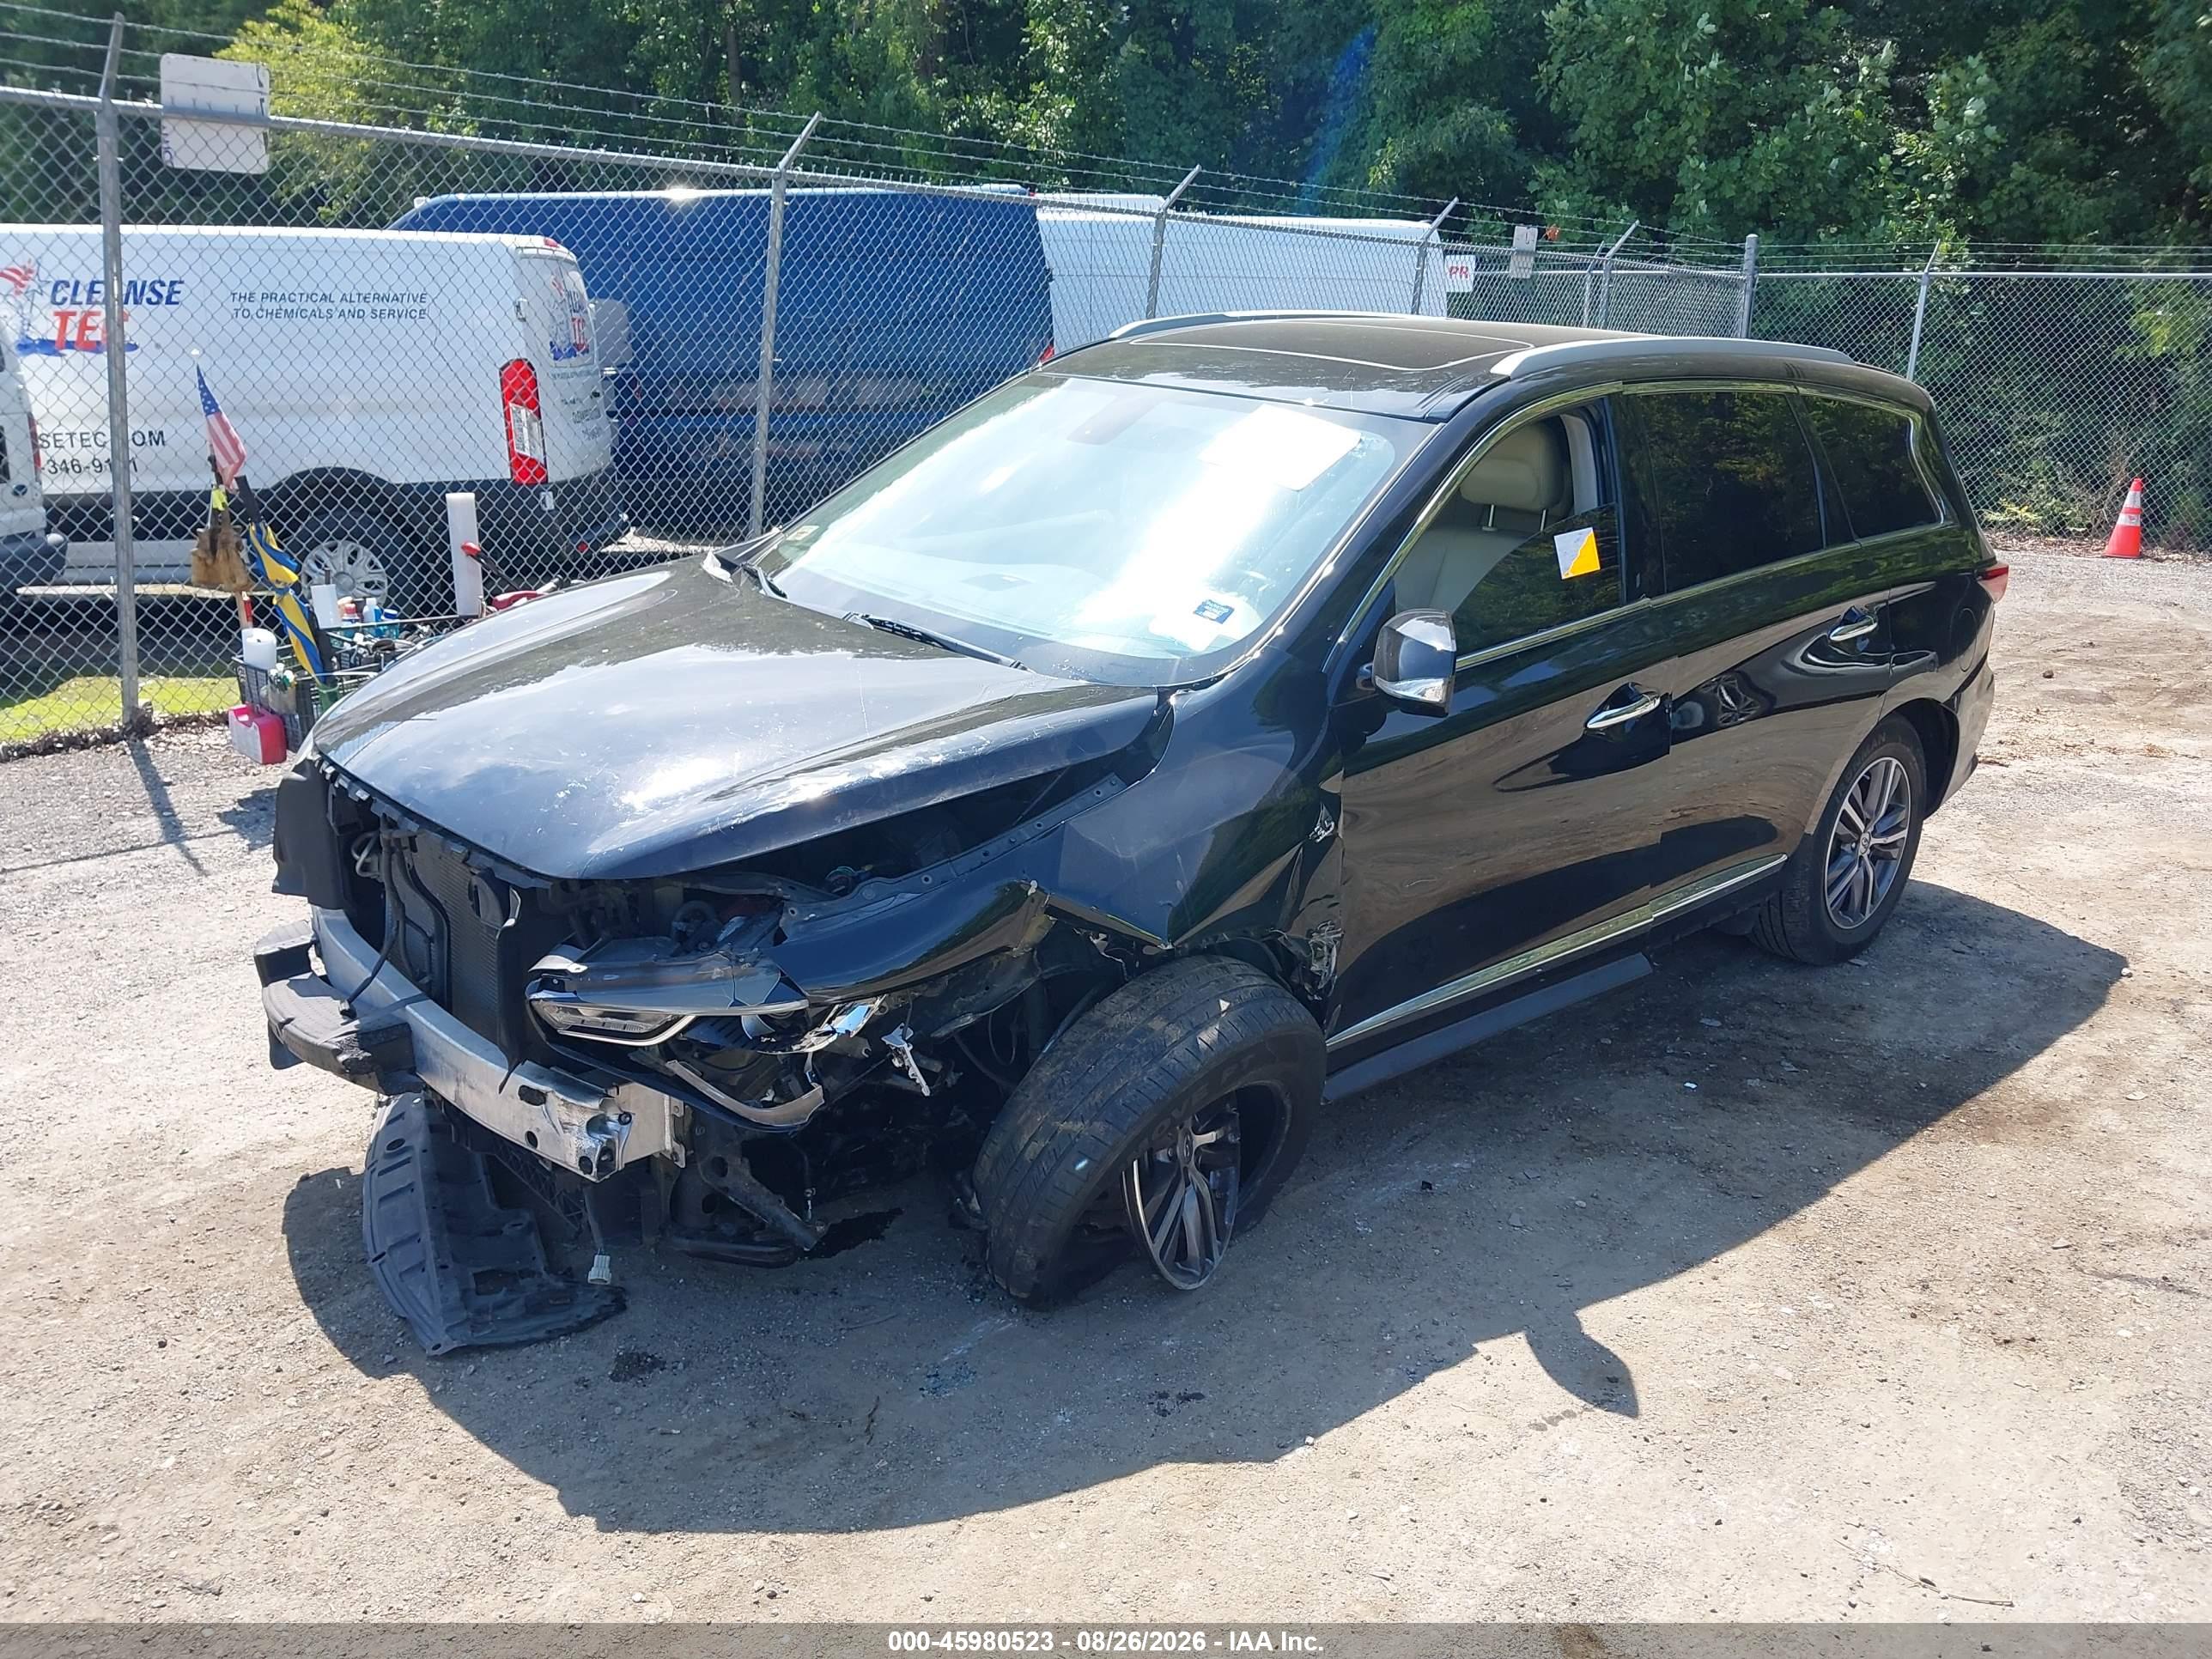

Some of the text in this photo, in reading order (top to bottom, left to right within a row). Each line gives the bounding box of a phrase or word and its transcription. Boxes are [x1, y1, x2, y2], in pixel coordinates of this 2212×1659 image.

[51, 279, 184, 306] CLENSE
[230, 292, 428, 303] THE PRACTICAL ALTERNATIVE
[233, 308, 427, 319] TO CHEMICALS AND SERVICE
